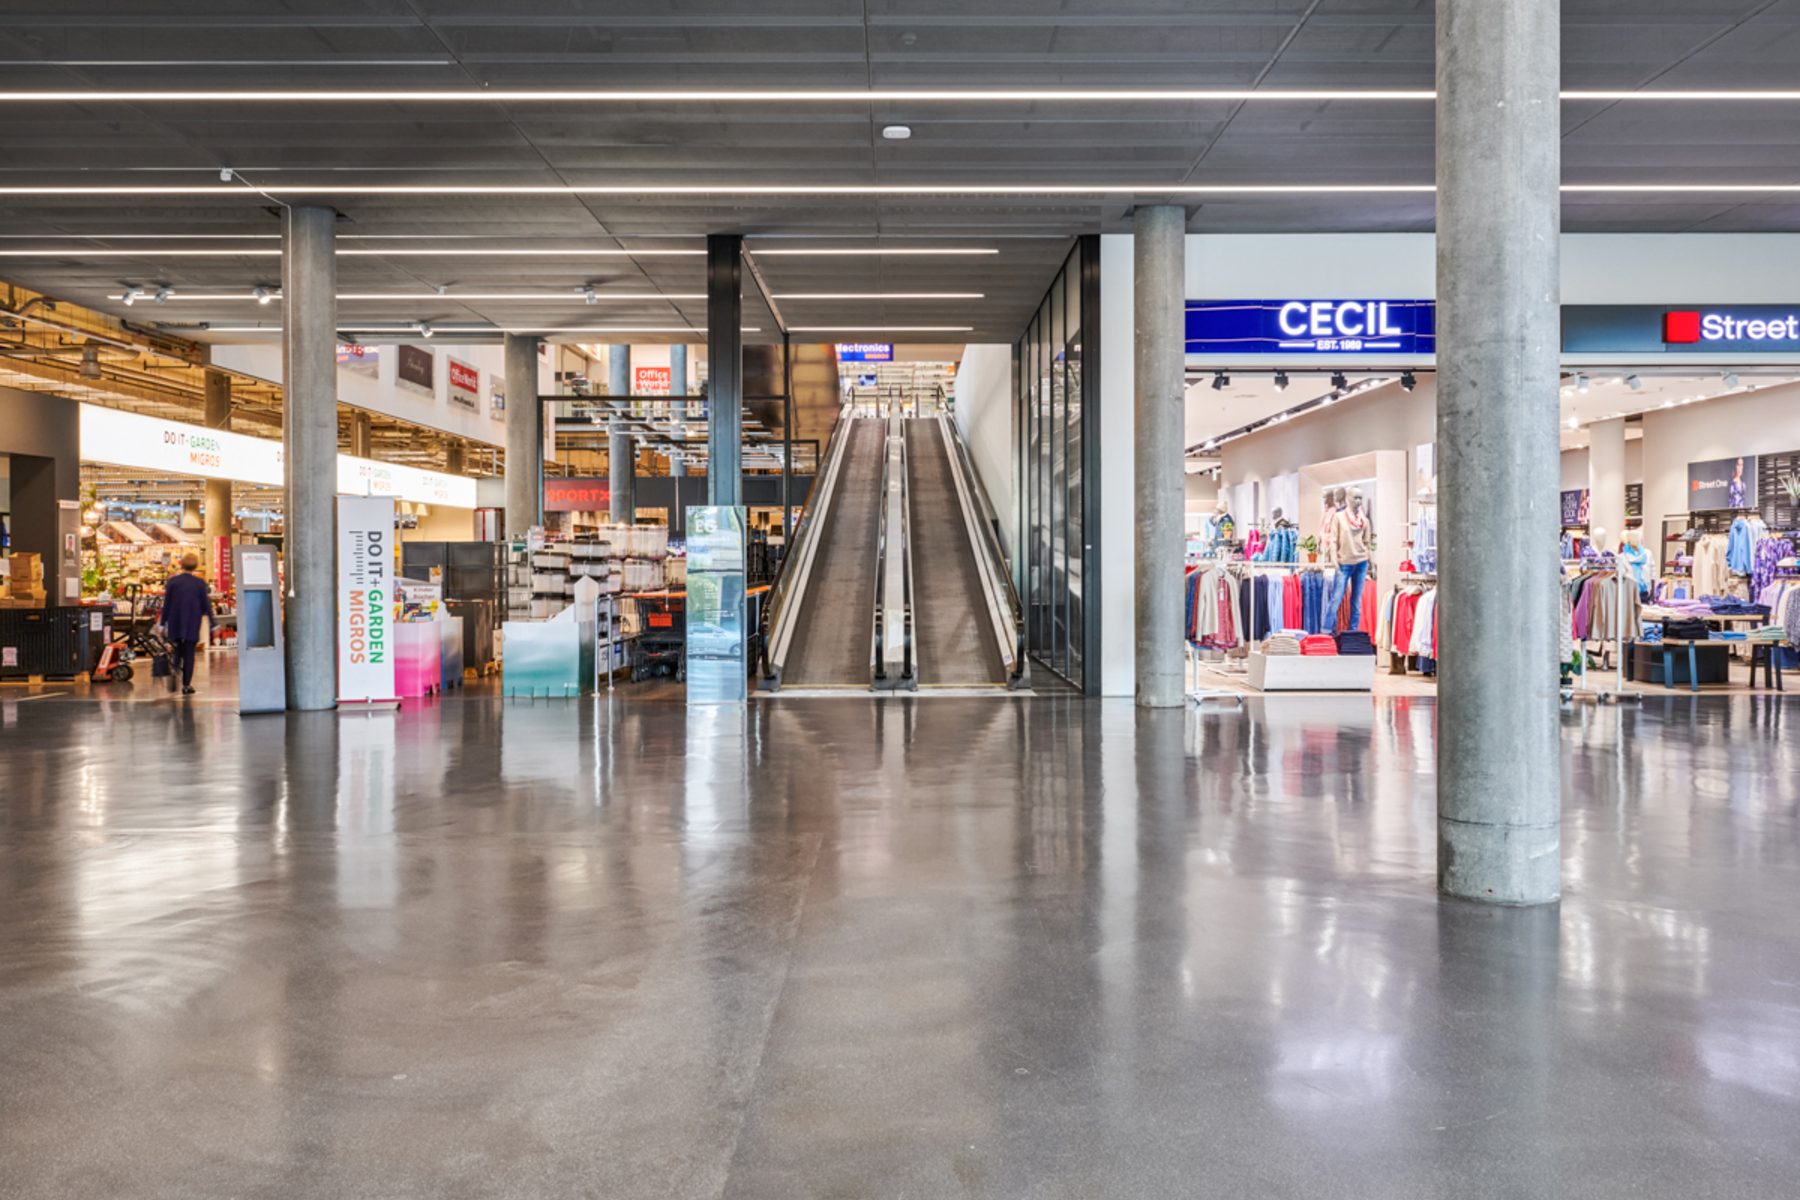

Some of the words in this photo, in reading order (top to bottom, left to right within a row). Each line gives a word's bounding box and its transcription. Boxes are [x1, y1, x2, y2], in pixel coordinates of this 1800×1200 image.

[1279, 301, 1402, 336] CECIL
[1701, 313, 1800, 340] Street
[639, 369, 668, 379] Office
[190, 451, 220, 468] MIGROS
[547, 488, 610, 502] SPORTX
[695, 519, 718, 534] EG
[367, 531, 383, 557] DO
[349, 590, 365, 664] MIGROS
